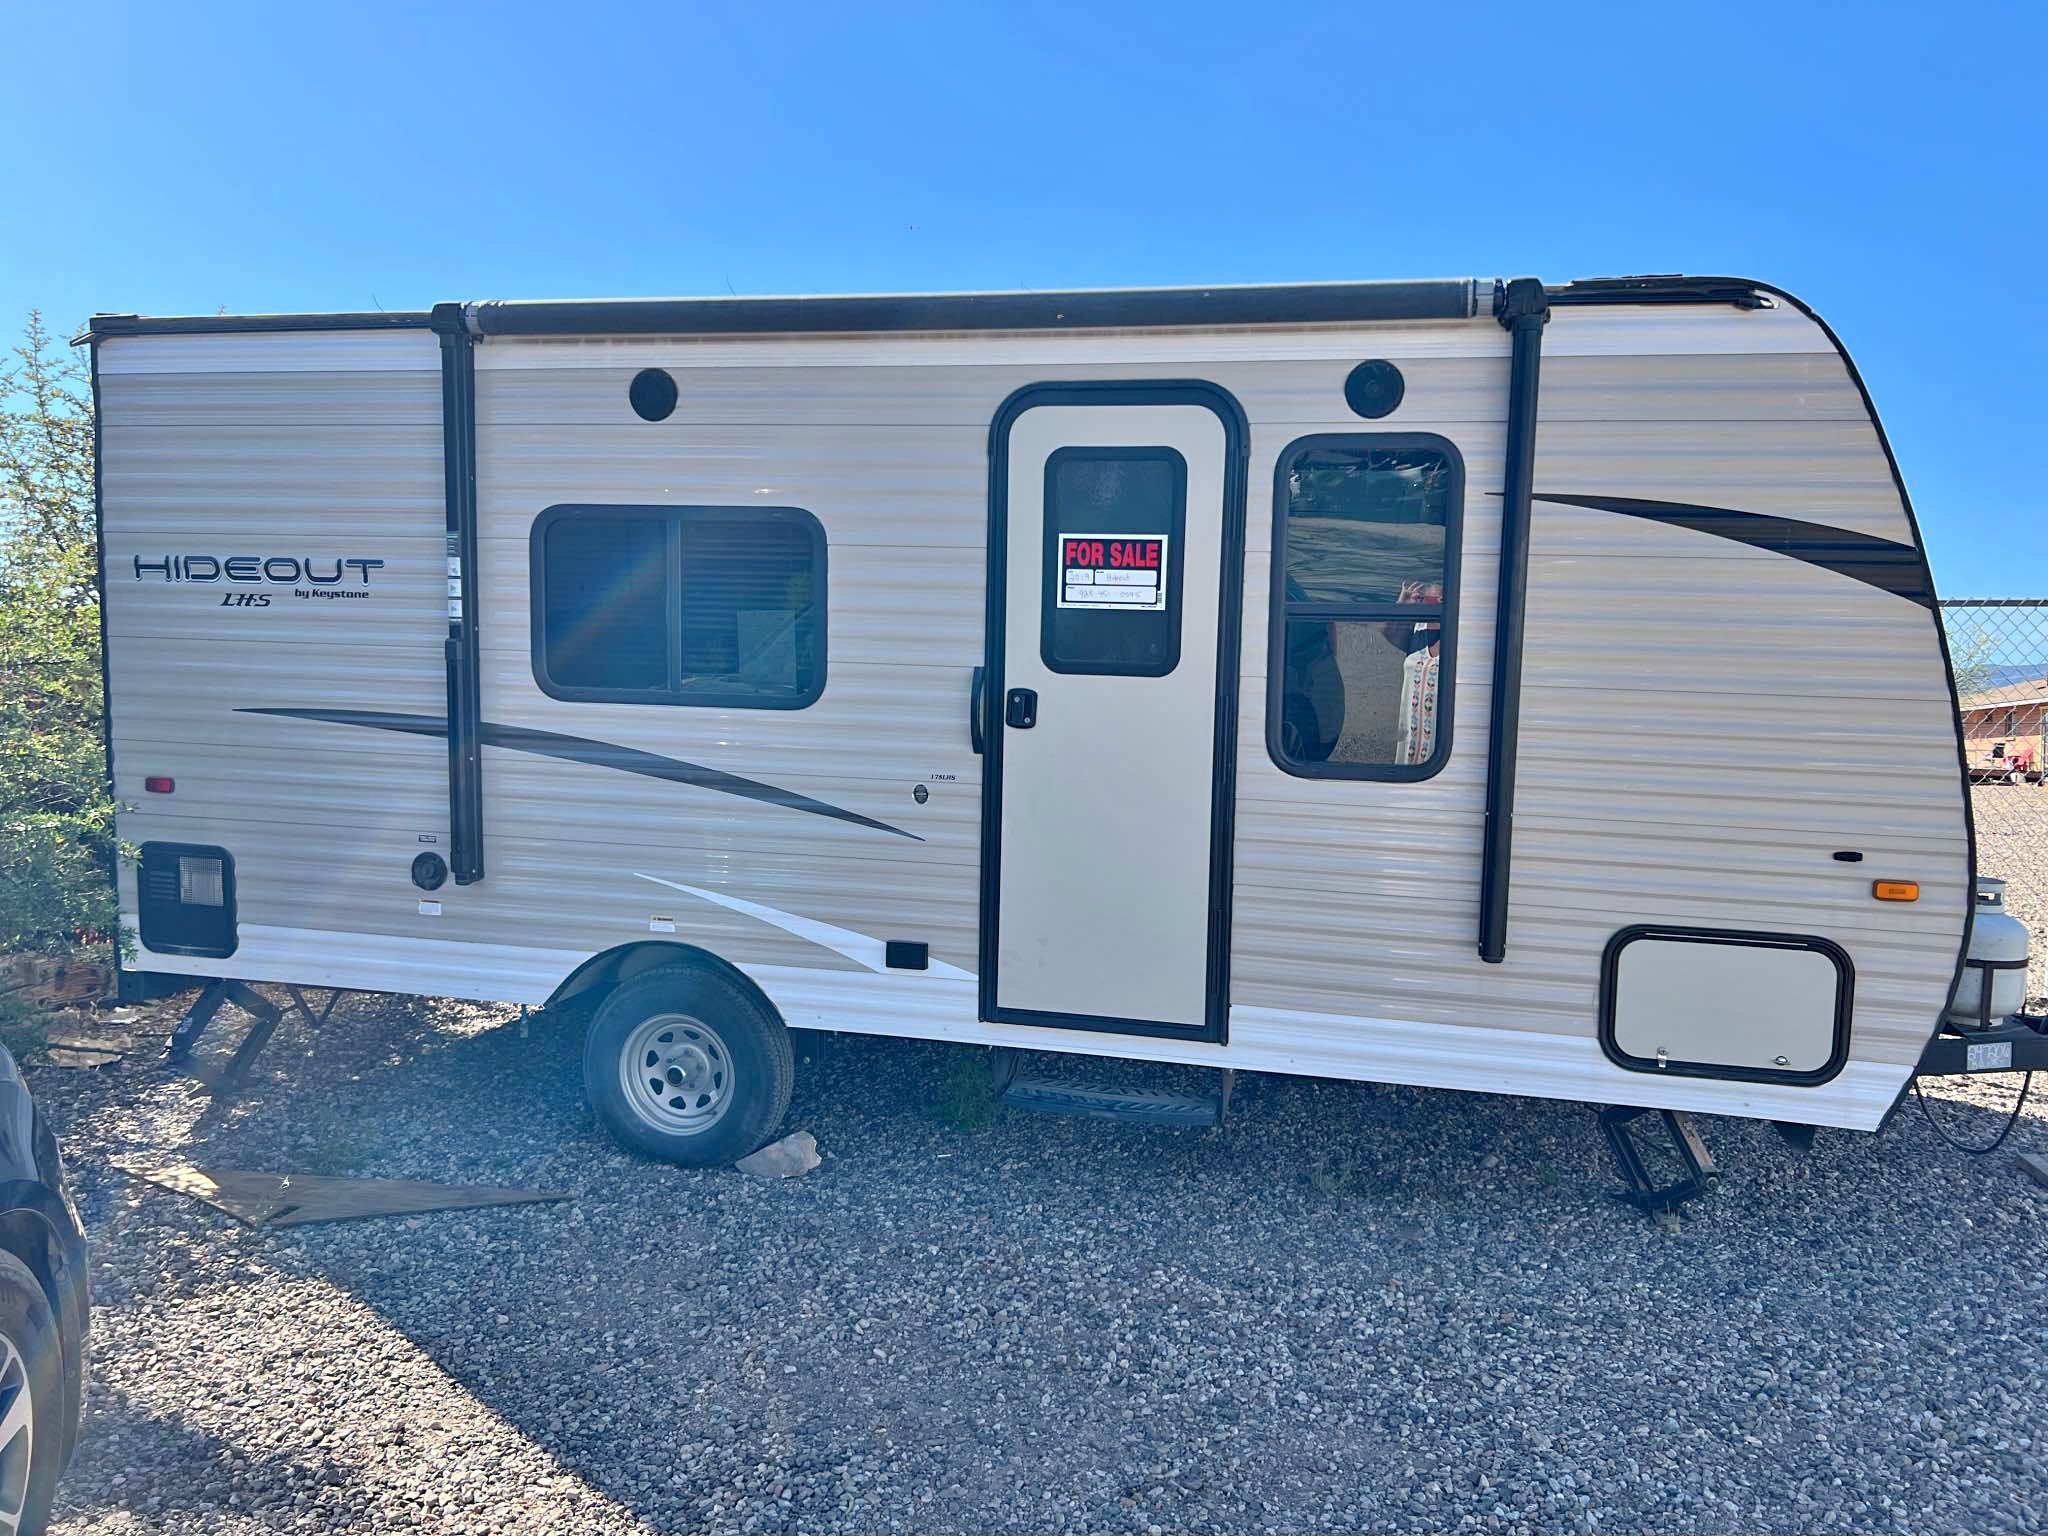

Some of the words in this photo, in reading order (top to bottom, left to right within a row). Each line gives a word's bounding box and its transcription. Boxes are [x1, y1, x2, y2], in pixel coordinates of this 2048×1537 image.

[1065, 542, 1104, 567] FOR
[1109, 542, 1159, 568] SALE
[133, 554, 385, 587] HIDEOUT
[294, 588, 309, 600] by
[312, 589, 369, 600] Keystone
